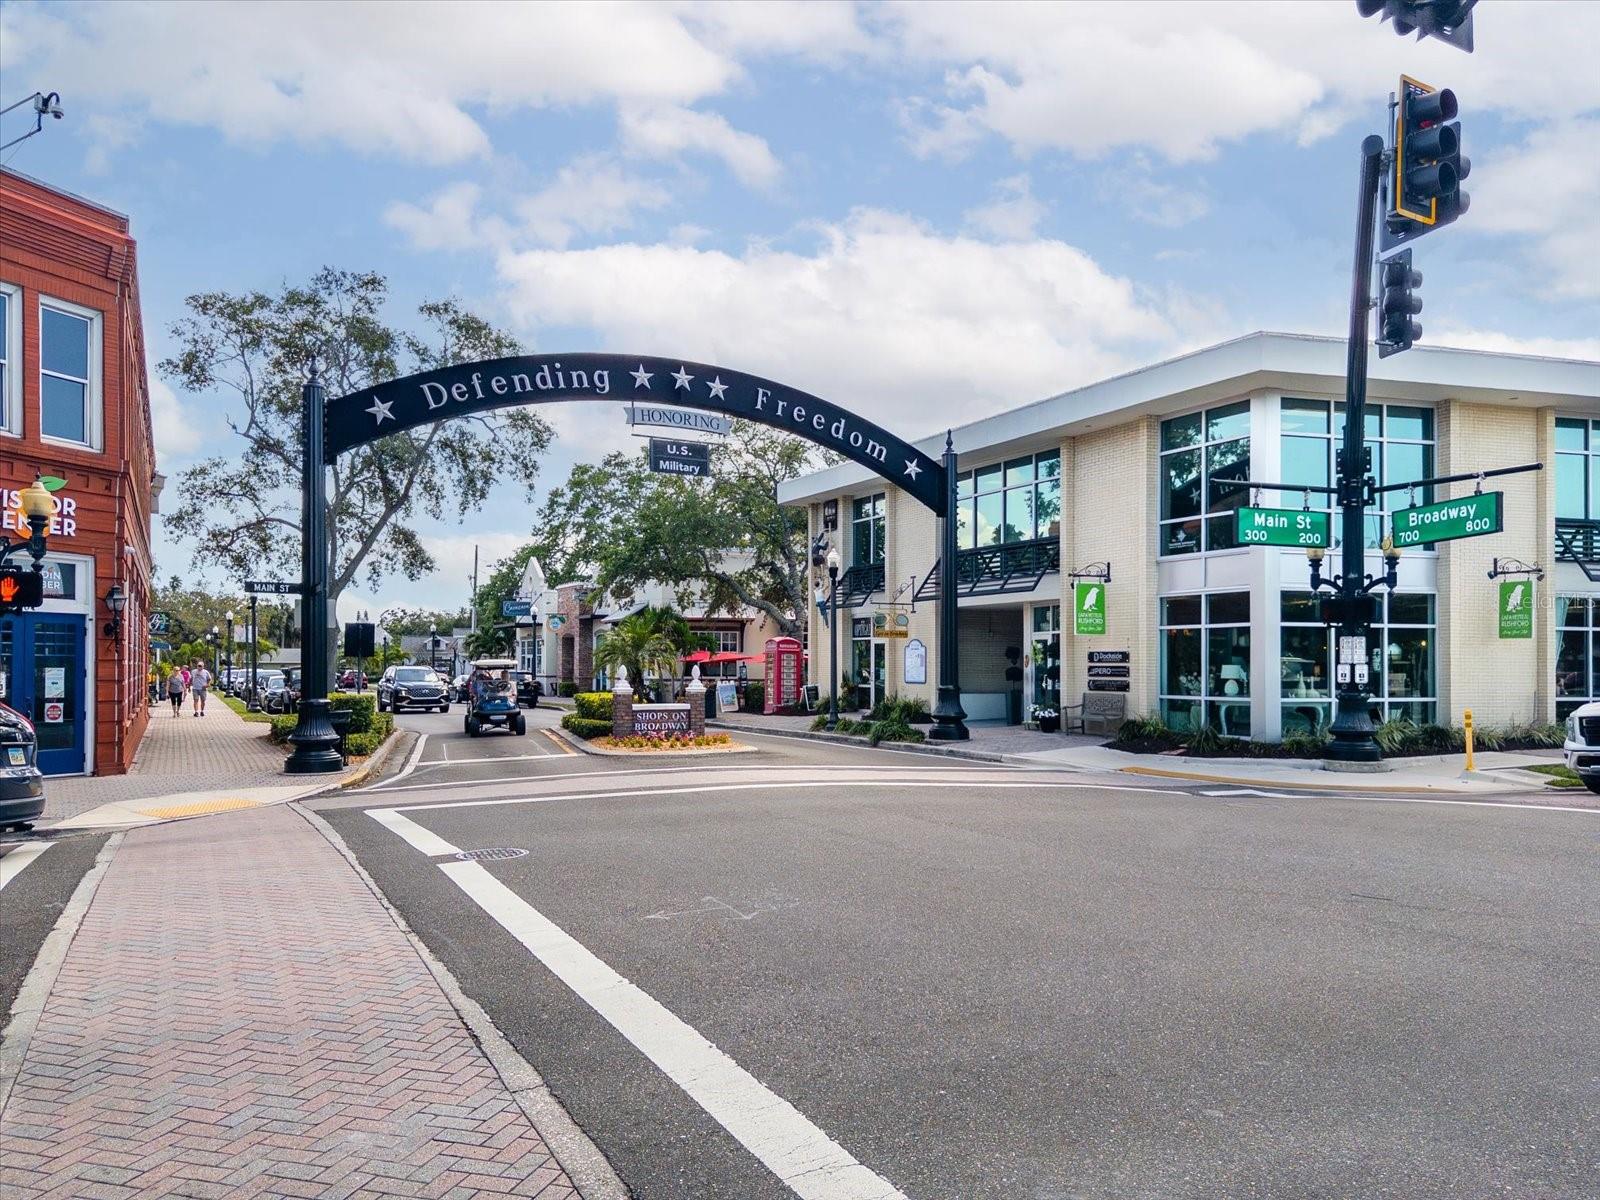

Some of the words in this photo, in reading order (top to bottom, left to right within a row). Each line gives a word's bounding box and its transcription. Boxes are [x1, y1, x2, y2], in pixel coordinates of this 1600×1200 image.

[420, 362, 609, 410] Defending
[755, 387, 888, 463] Freedom
[641, 409, 720, 430] HONORING
[667, 445, 692, 456] U.S.
[659, 460, 700, 475] Military
[1254, 512, 1288, 528] Main
[1296, 514, 1312, 529] St
[1408, 503, 1477, 527] Broadway
[1465, 518, 1490, 533] 800
[1244, 530, 1268, 541] 300
[1298, 532, 1321, 544] 200
[1399, 530, 1420, 543] 700
[253, 583, 276, 592] MAIN
[279, 584, 290, 593] ST
[636, 712, 668, 720] SHOPS
[672, 712, 687, 720] ON
[635, 722, 688, 731] BROADWAY
